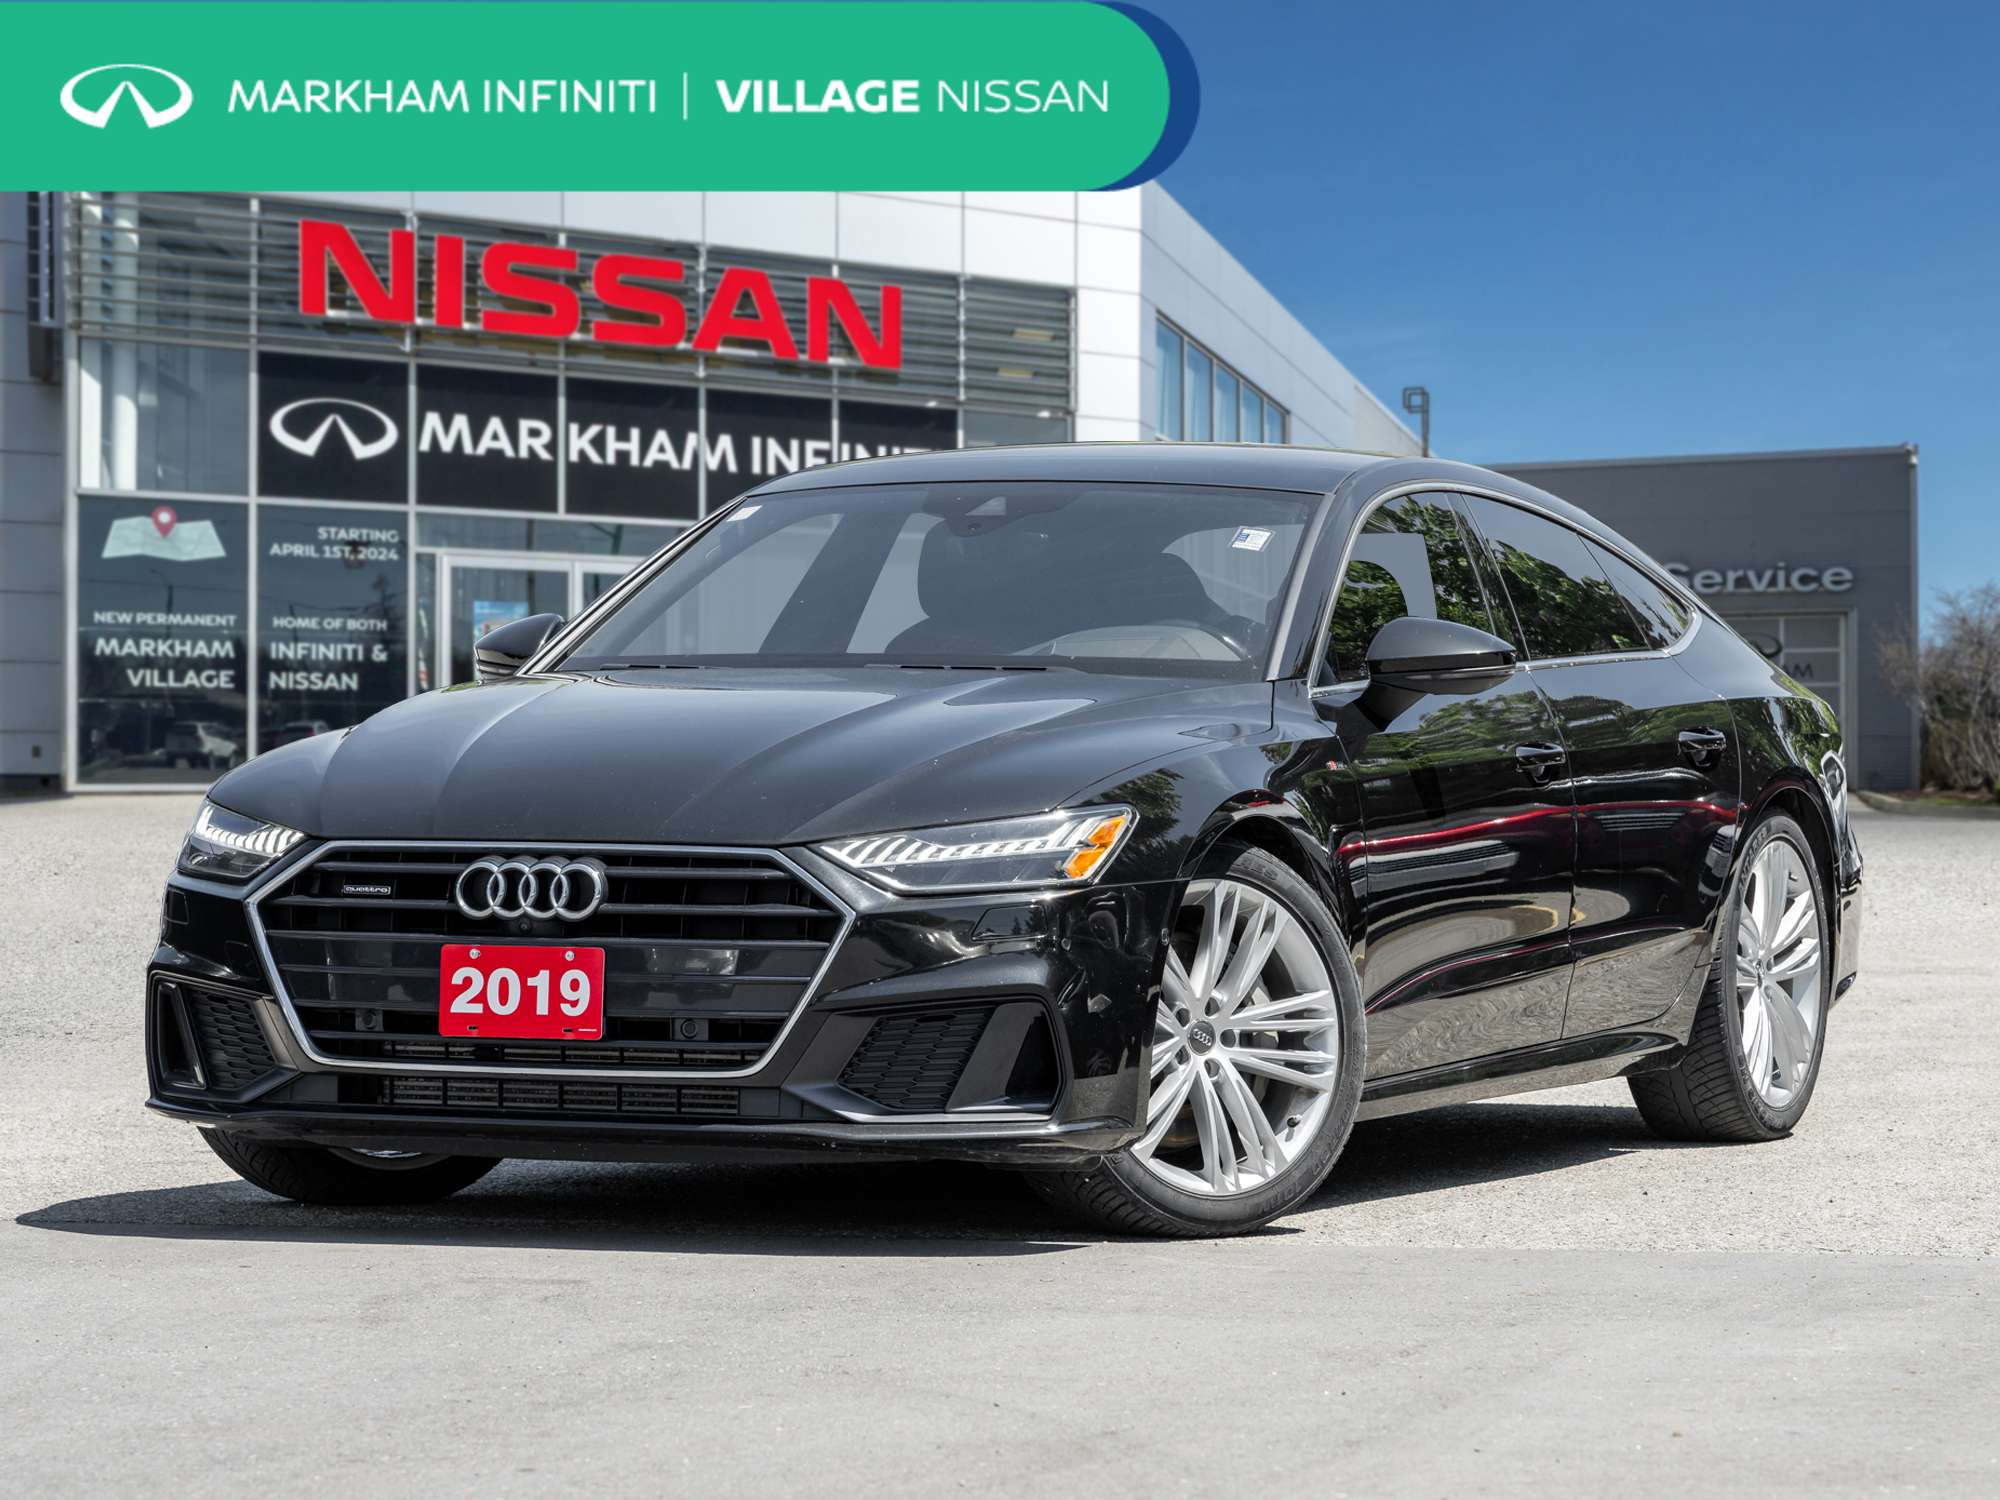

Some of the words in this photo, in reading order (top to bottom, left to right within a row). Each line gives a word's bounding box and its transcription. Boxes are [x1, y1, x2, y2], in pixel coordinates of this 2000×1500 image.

[299, 219, 903, 370] NISSAN
[418, 410, 738, 474] MARKHAM
[317, 526, 400, 543] STARTING
[269, 543, 320, 558] APRIL
[357, 546, 400, 561] 2024
[93, 611, 133, 625] NEW
[135, 612, 237, 628] PERMANENT
[272, 616, 321, 630] HOME
[322, 617, 344, 631] OF
[346, 618, 388, 632] BOTH
[95, 638, 235, 660] MARKHAM
[270, 642, 364, 662] INFINITI
[371, 643, 388, 662] &
[126, 669, 235, 689] VILLAGE
[269, 671, 359, 691] NISSAN
[449, 966, 592, 1017] 2019
